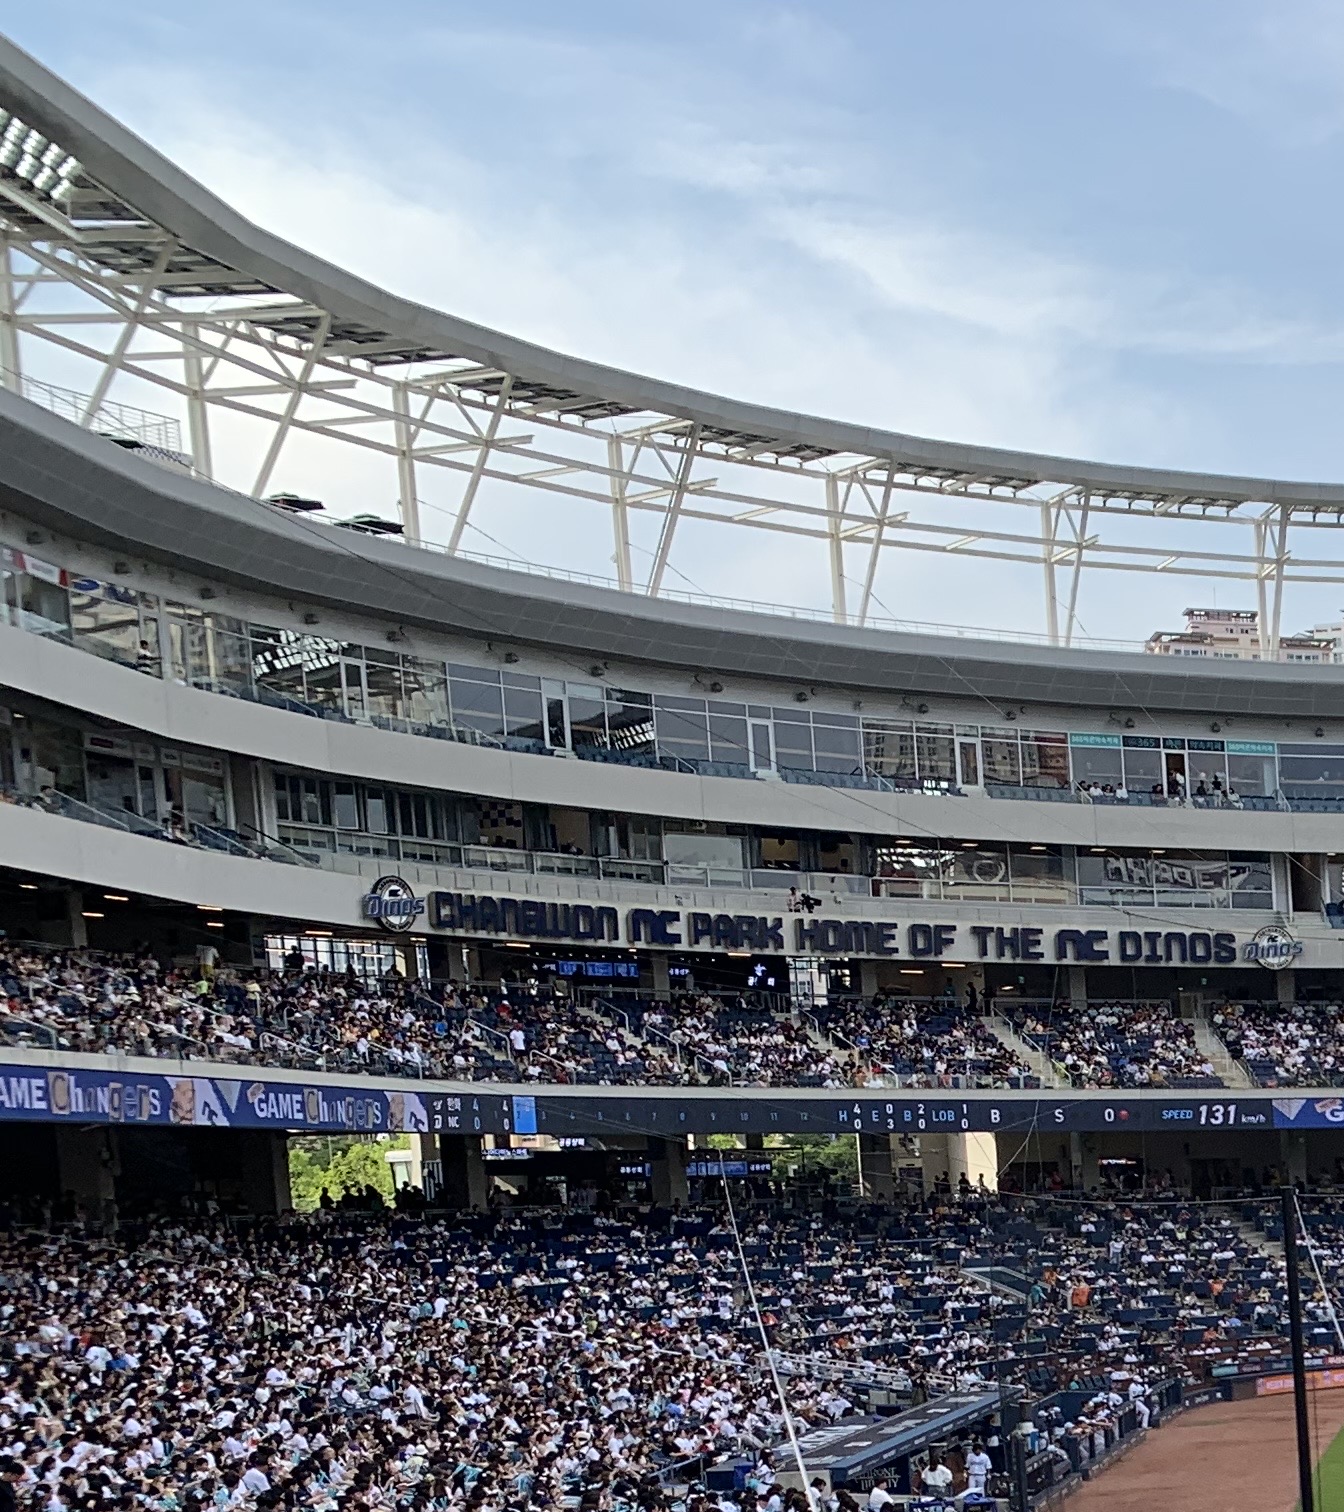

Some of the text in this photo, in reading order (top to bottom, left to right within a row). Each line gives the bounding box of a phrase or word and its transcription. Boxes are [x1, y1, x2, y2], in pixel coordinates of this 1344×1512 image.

[629, 907, 682, 945] NC
[688, 911, 786, 951] PARK
[797, 917, 900, 955] HOME
[907, 922, 957, 958] OF
[970, 925, 1045, 960] THE
[1056, 928, 1109, 963] NC
[1119, 930, 1238, 964] DINOS
[253, 1094, 303, 1121] GAME
[839, 1110, 848, 1123] H
[872, 1109, 879, 1122] E
[904, 1109, 912, 1122] B
[932, 1109, 955, 1122] LOB
[990, 1109, 1000, 1124] B
[1054, 1108, 1065, 1124] S
[1161, 1108, 1194, 1121] SPEED
[1200, 1104, 1238, 1126] 131
[1241, 1112, 1267, 1125] km/h
[853, 1103, 861, 1115] 4
[885, 1103, 893, 1115] 0
[917, 1103, 925, 1115] 2
[962, 1103, 968, 1115] 1
[448, 1115, 461, 1129] NC
[854, 1118, 862, 1130] 0
[886, 1118, 894, 1130] 3
[918, 1118, 926, 1130] 0
[961, 1118, 968, 1130] 0
